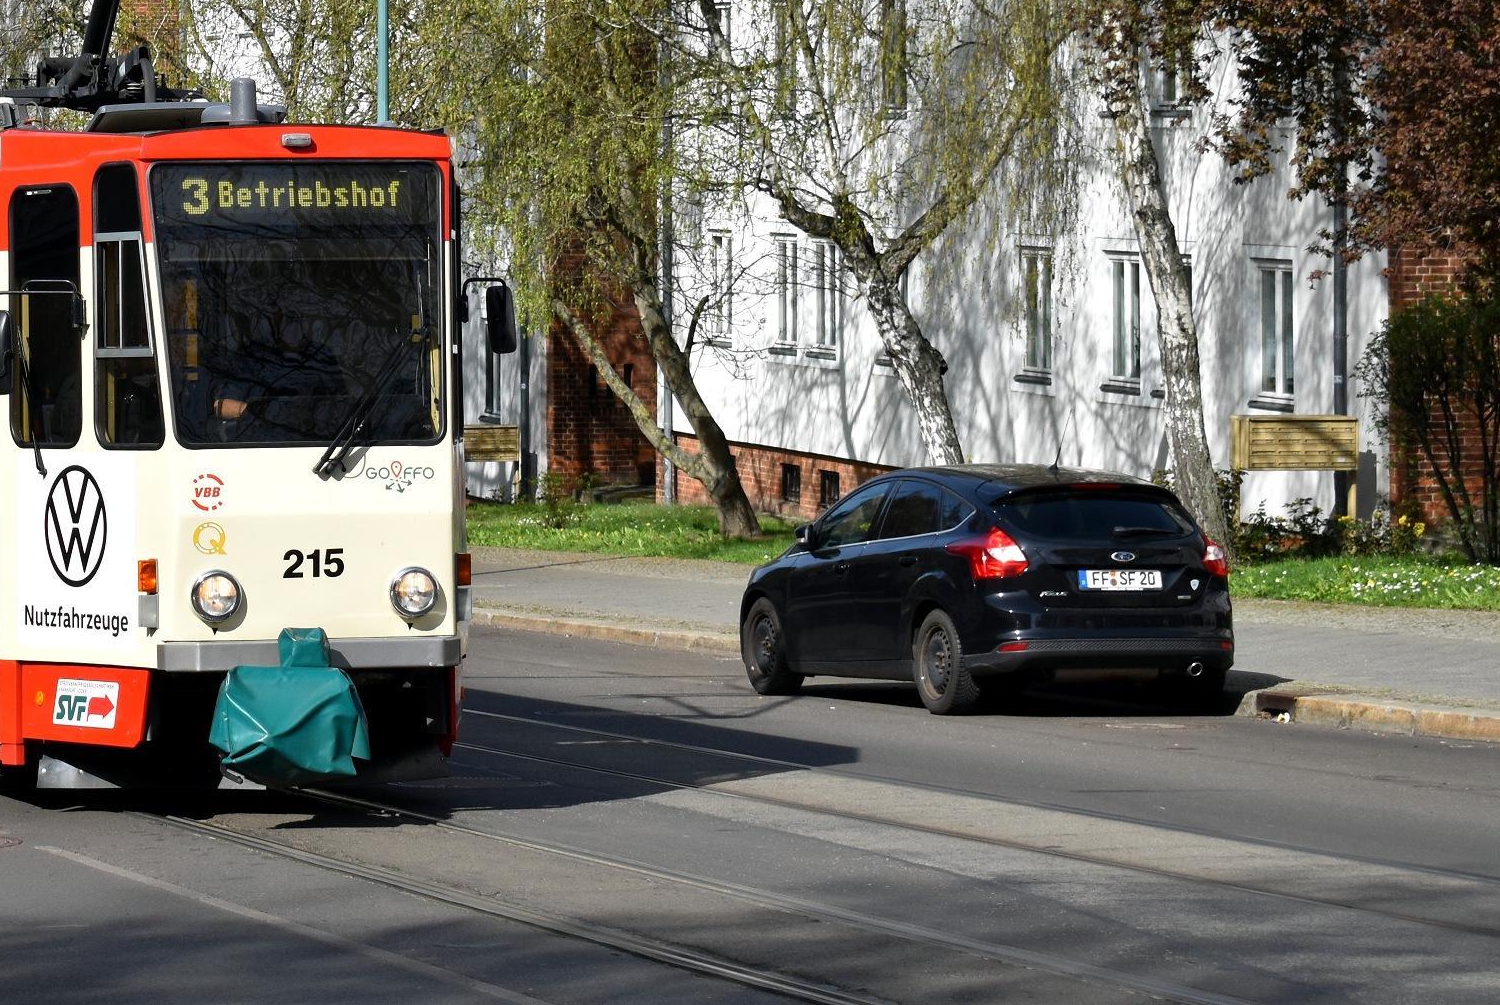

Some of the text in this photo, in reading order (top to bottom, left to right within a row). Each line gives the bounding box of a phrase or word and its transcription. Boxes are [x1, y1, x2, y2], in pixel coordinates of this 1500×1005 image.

[182, 179, 400, 215] 3 Betriebshof
[194, 486, 221, 498] VBB
[283, 548, 345, 579] 215
[1092, 571, 1156, 586] FF SF 20
[24, 604, 129, 637] Nutzfahrzeuge
[55, 694, 88, 722] SVF
